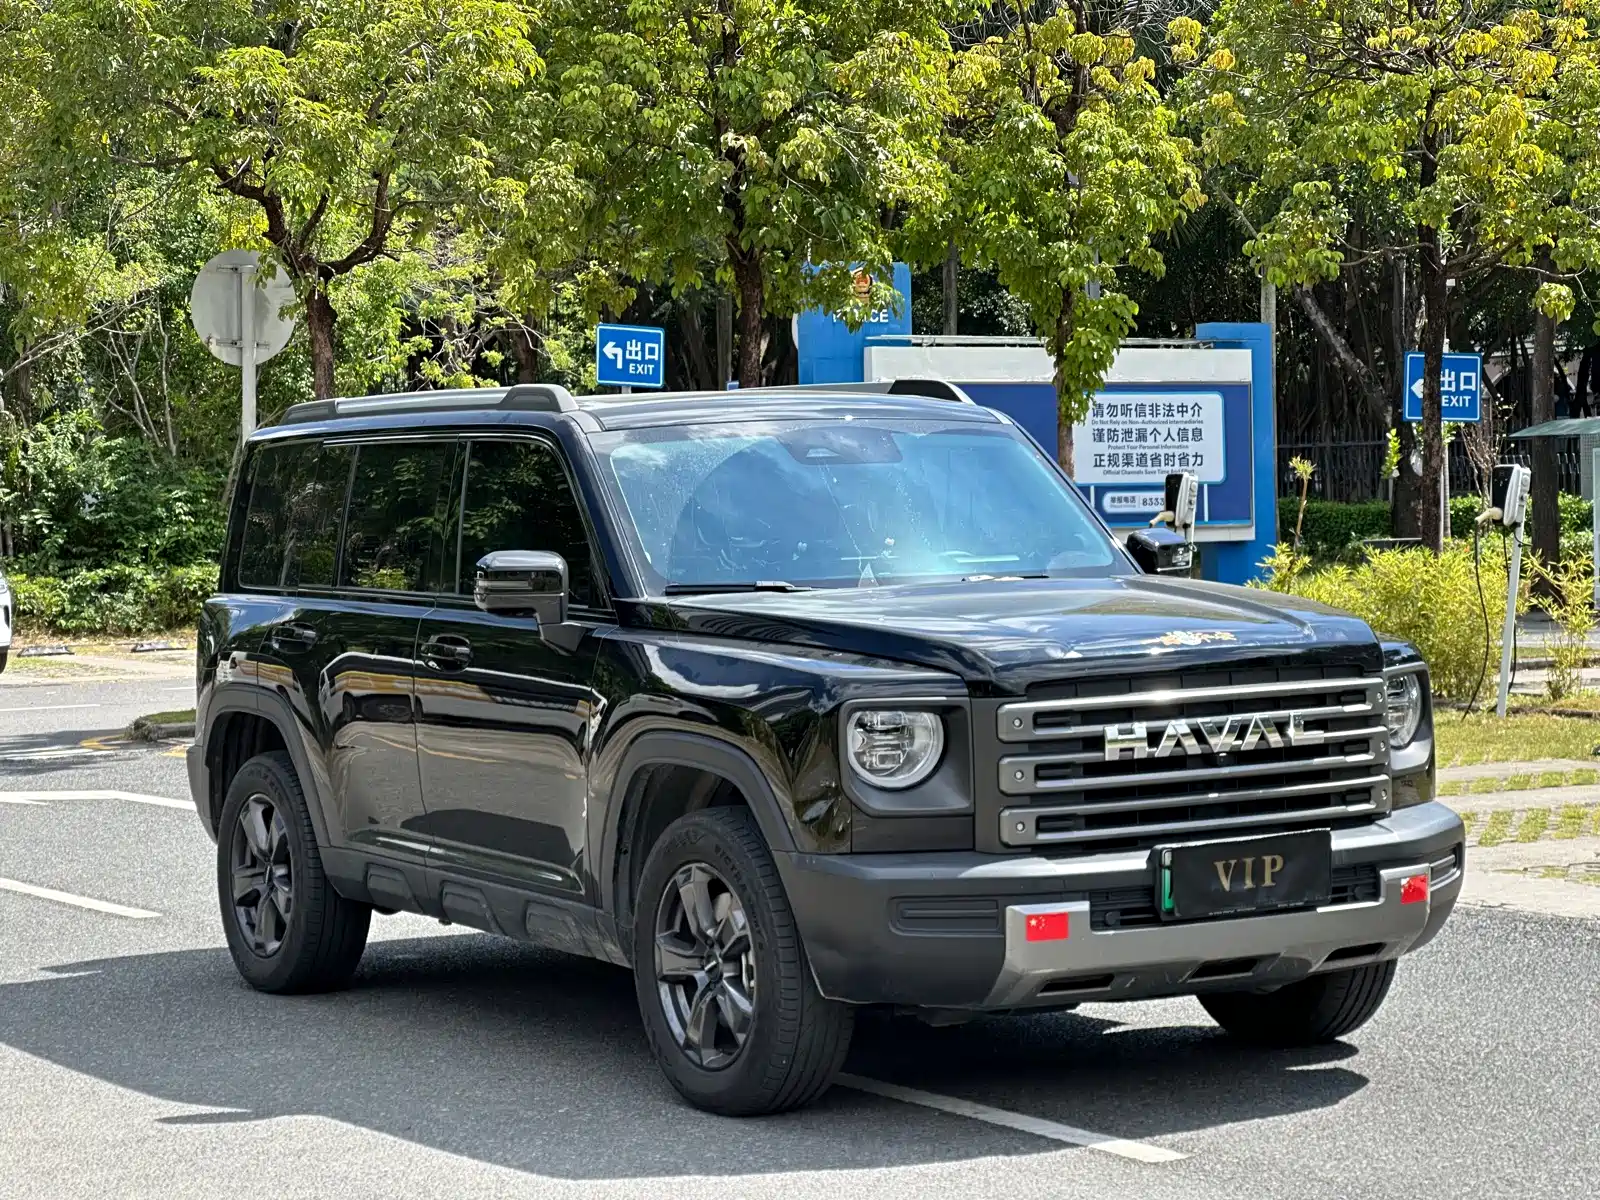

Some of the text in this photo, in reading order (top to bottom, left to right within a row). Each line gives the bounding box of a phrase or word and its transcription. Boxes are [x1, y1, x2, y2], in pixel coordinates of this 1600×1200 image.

[626, 339, 659, 361] 出口
[629, 363, 655, 376] EXIT
[1441, 368, 1476, 392] 出口
[1441, 395, 1472, 408] EXIT
[1092, 402, 1202, 418] 请勿听信非法中介
[1092, 427, 1204, 443] 谨防泄漏个人信息
[1093, 452, 1204, 468] 正规渠道省时省力
[1104, 712, 1324, 761] HAVAL
[1213, 854, 1284, 892] VIP
